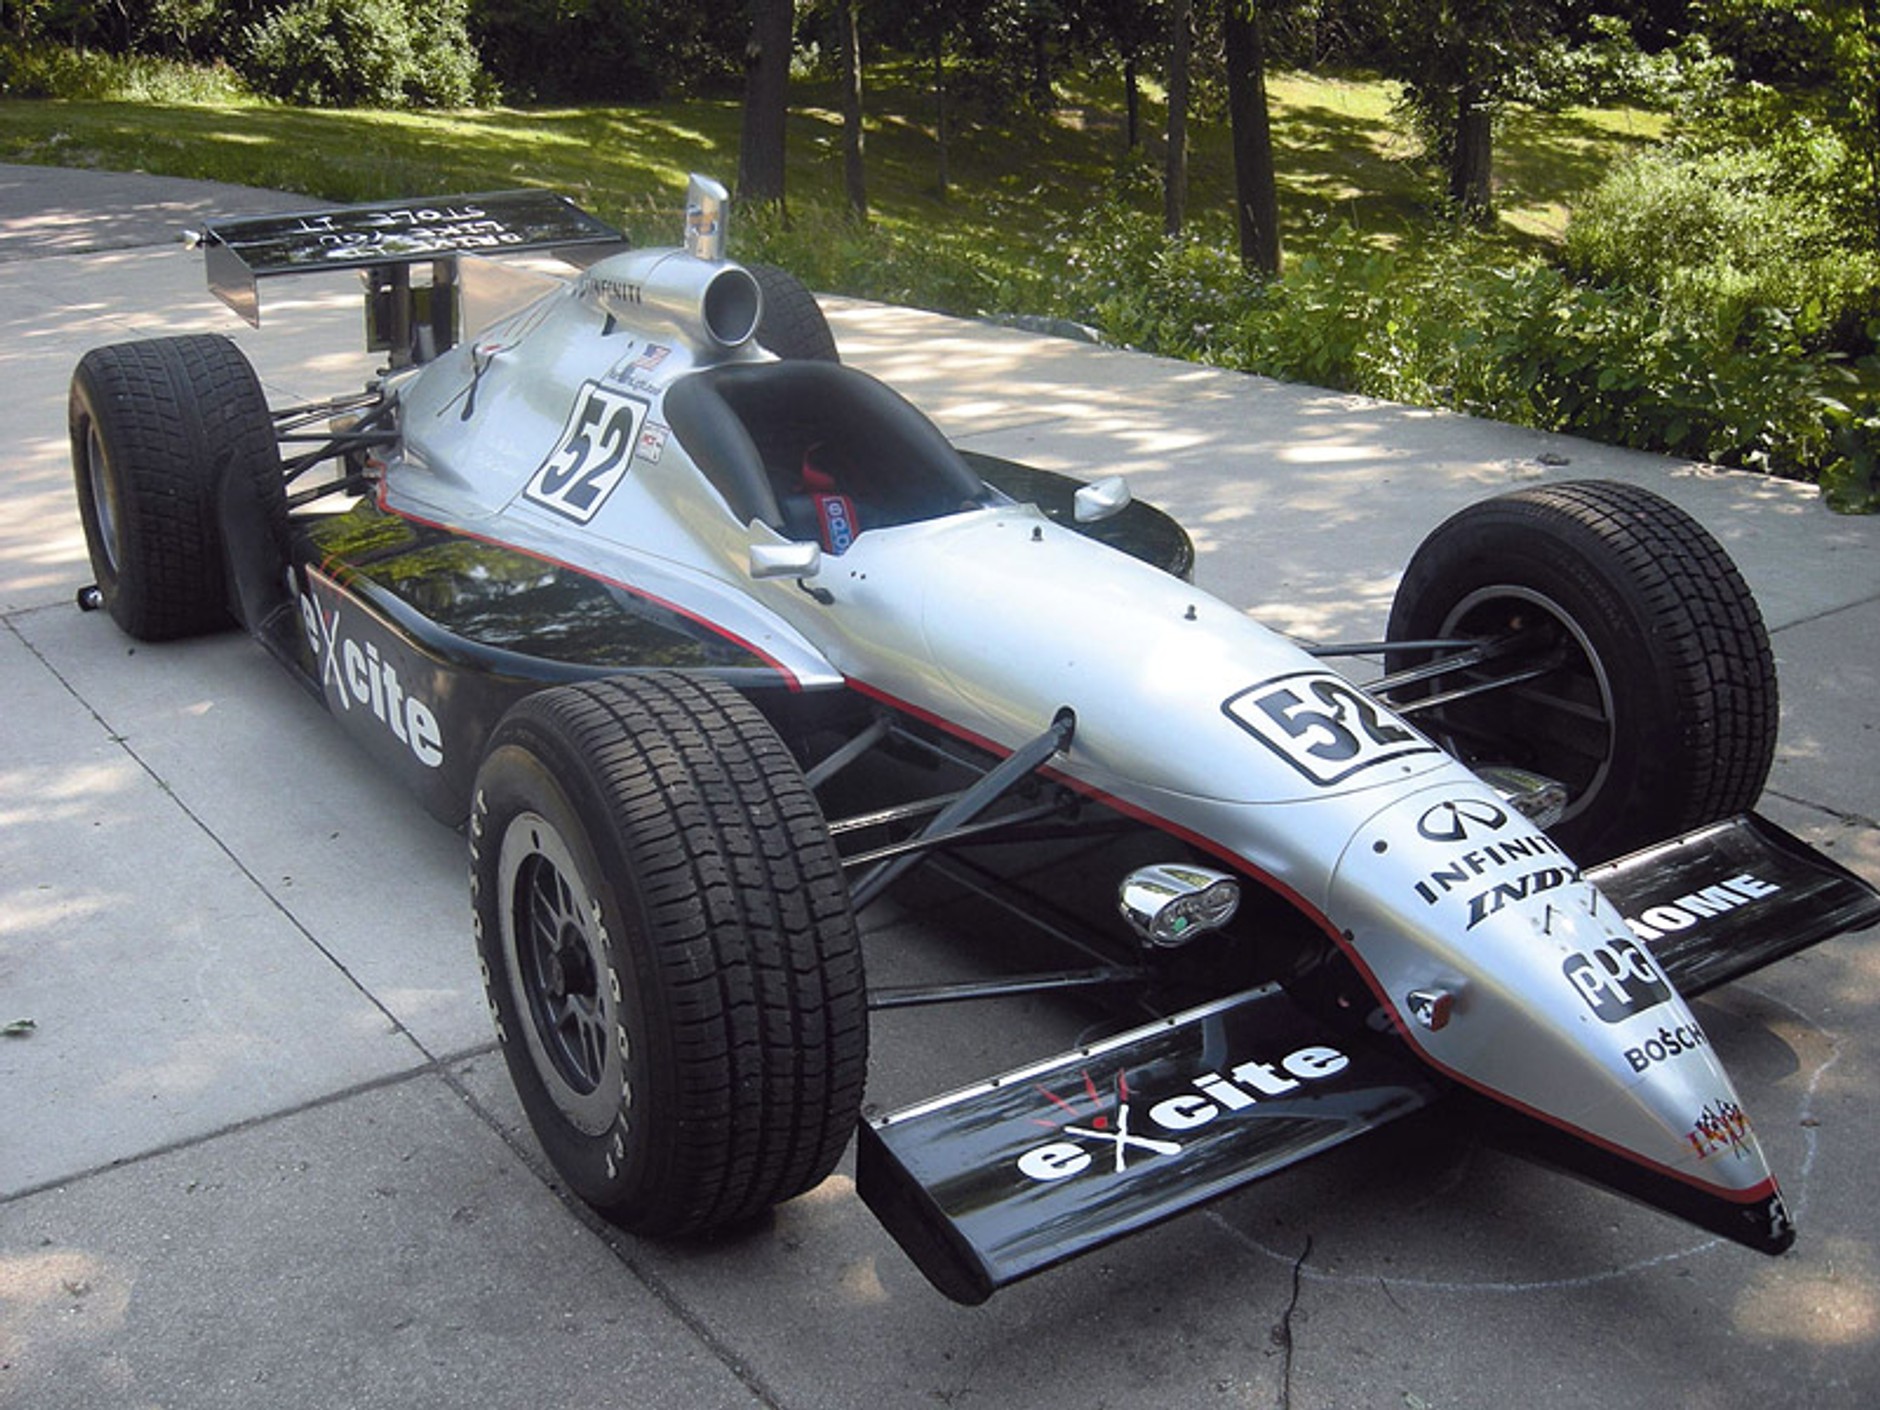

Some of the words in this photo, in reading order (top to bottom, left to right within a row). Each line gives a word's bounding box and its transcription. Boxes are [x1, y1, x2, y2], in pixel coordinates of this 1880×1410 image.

[540, 395, 633, 511] 52
[301, 592, 443, 768] eXcite
[1254, 680, 1416, 762] 52
[1466, 866, 1583, 931] INDY
[1567, 941, 1661, 1010] PPG
[1624, 1022, 1707, 1073] BOSCH
[1017, 1046, 1349, 1181] eXcite
